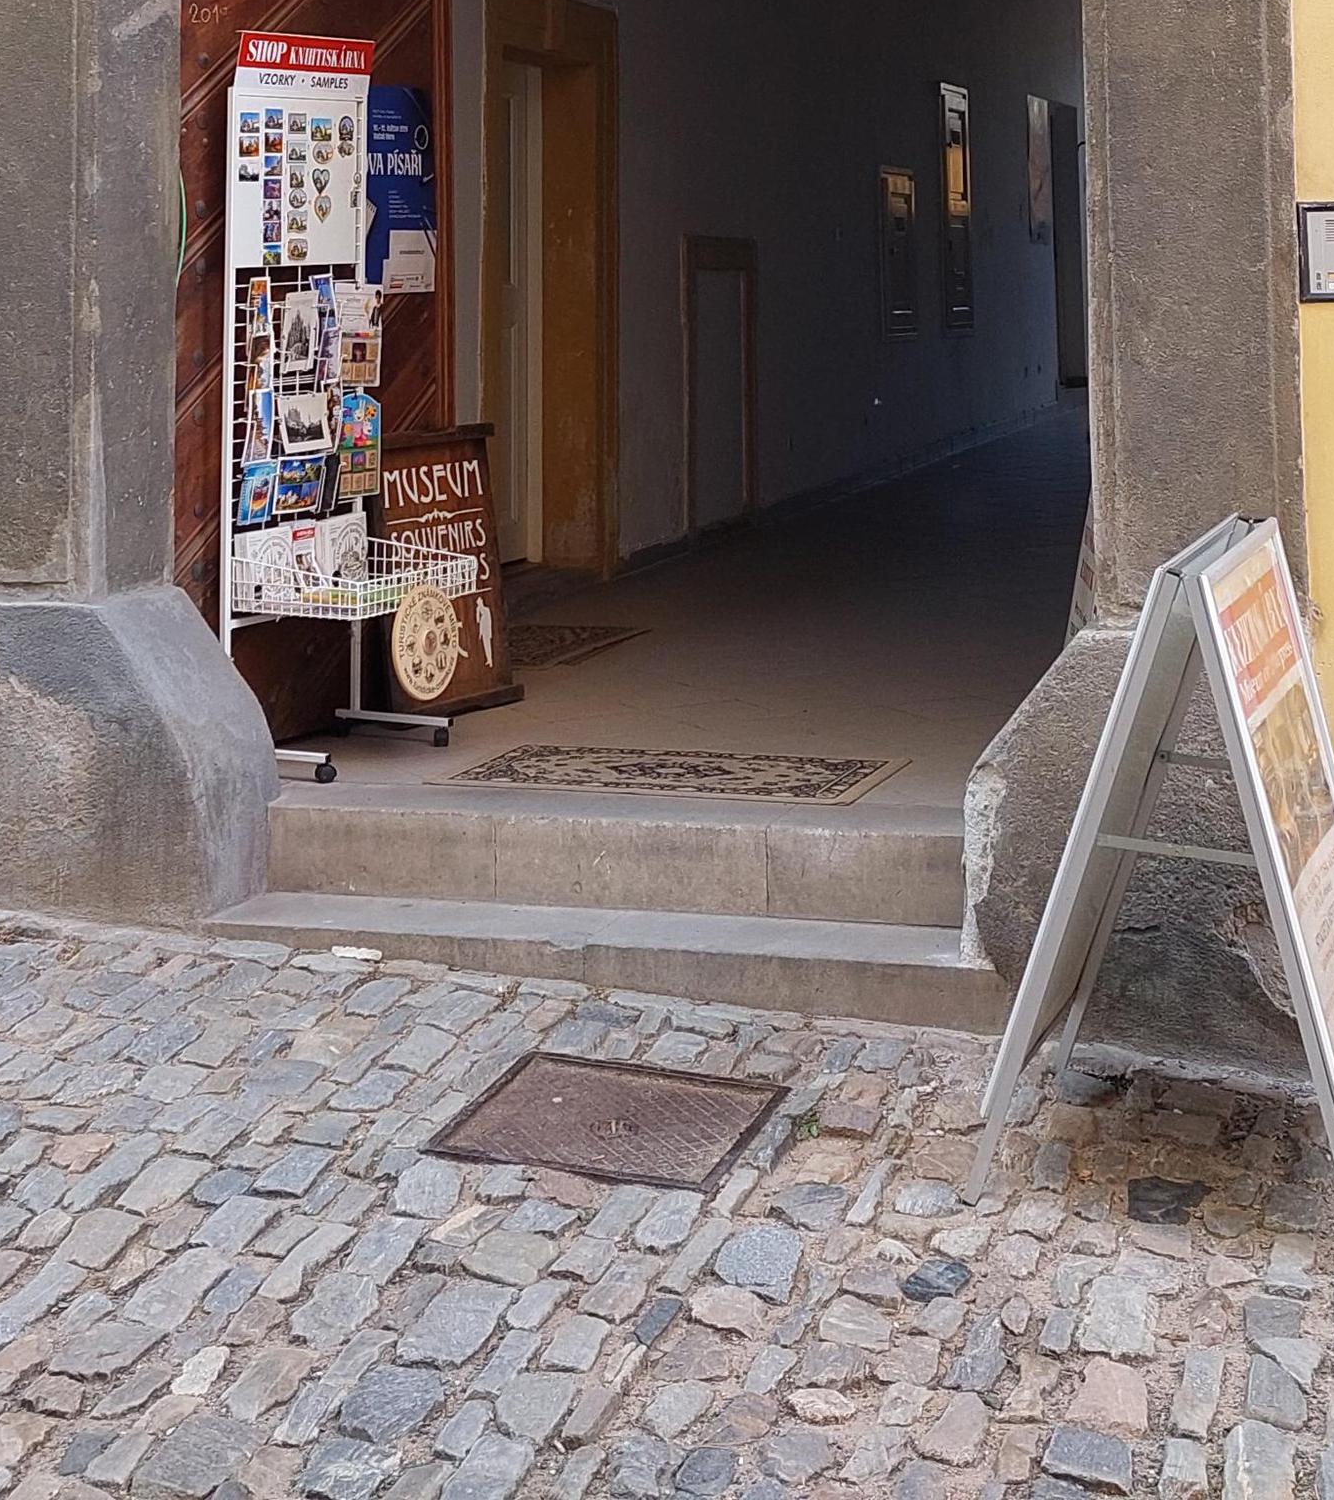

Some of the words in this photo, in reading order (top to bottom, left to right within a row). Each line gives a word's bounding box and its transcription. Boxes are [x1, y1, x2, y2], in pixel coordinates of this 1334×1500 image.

[247, 39, 287, 63] SHOP
[289, 45, 365, 69] KNIHTISKÁRNA
[259, 73, 296, 86] VZORKY
[310, 76, 348, 89] SAMPLES
[367, 152, 384, 176] VA
[387, 149, 422, 176] PÍSAŘI
[382, 460, 483, 508] MUSEUM
[391, 519, 486, 559] SOUVENIRS
